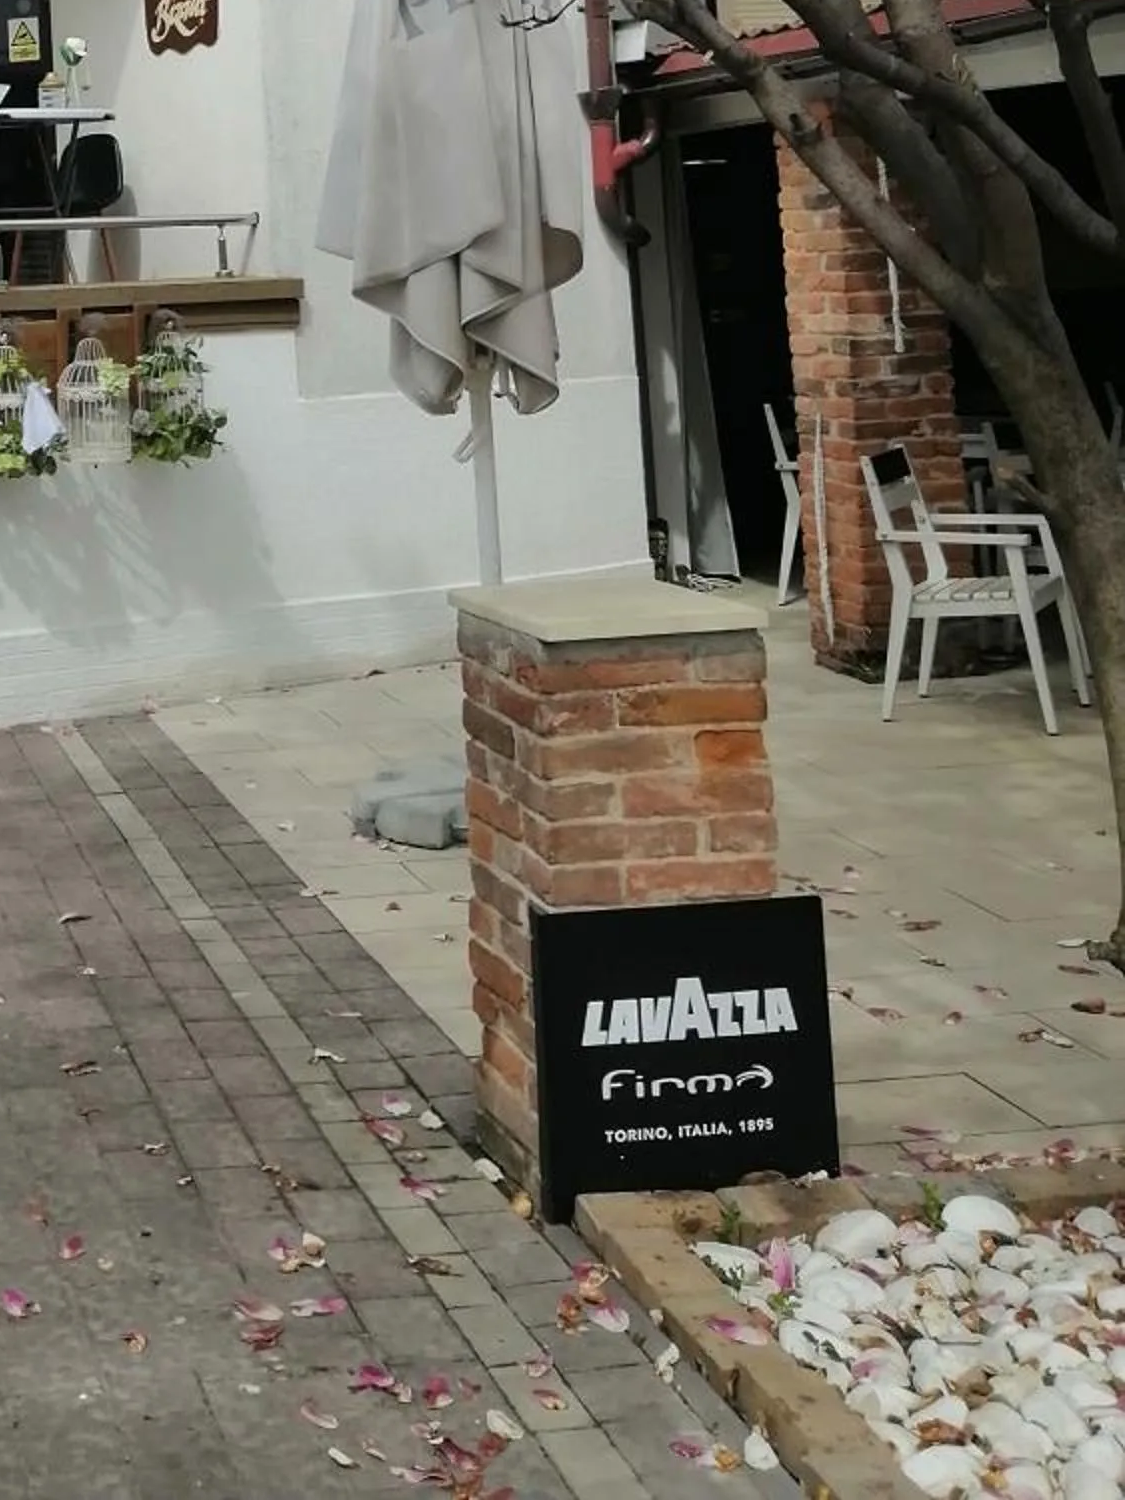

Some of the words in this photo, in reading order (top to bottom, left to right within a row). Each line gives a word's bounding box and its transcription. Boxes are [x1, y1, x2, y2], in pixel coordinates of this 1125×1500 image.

[581, 977, 798, 1046] LAVAZZA
[604, 1126, 672, 1144] TORINO,
[678, 1122, 732, 1138] ITALIA,
[739, 1117, 774, 1133] 1895
